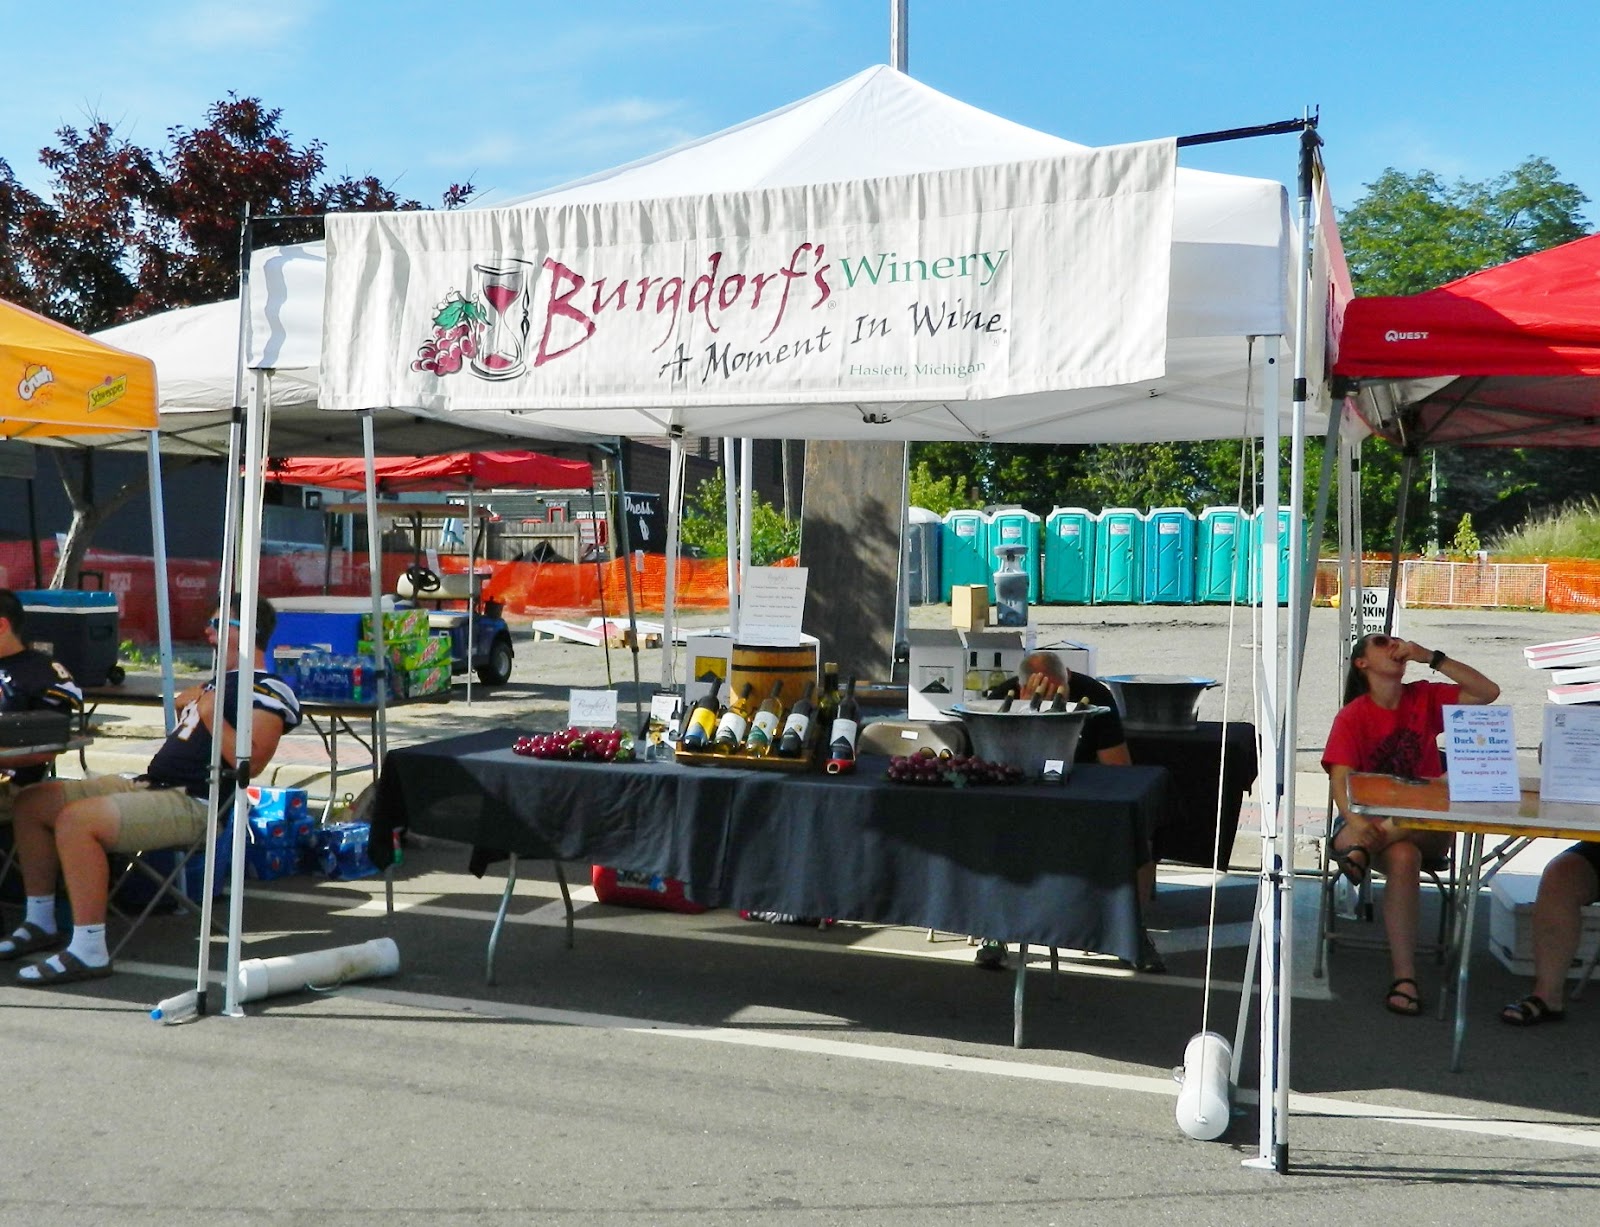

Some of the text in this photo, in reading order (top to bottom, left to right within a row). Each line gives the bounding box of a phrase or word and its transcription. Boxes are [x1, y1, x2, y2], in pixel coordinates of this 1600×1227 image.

[534, 242, 1009, 367] Burgdorf's Winery
[658, 298, 1007, 384] A Moment In Wine.
[850, 362, 987, 380] Haslett, Michigan
[1363, 594, 1378, 605] NO
[1454, 736, 1475, 744] Duck
